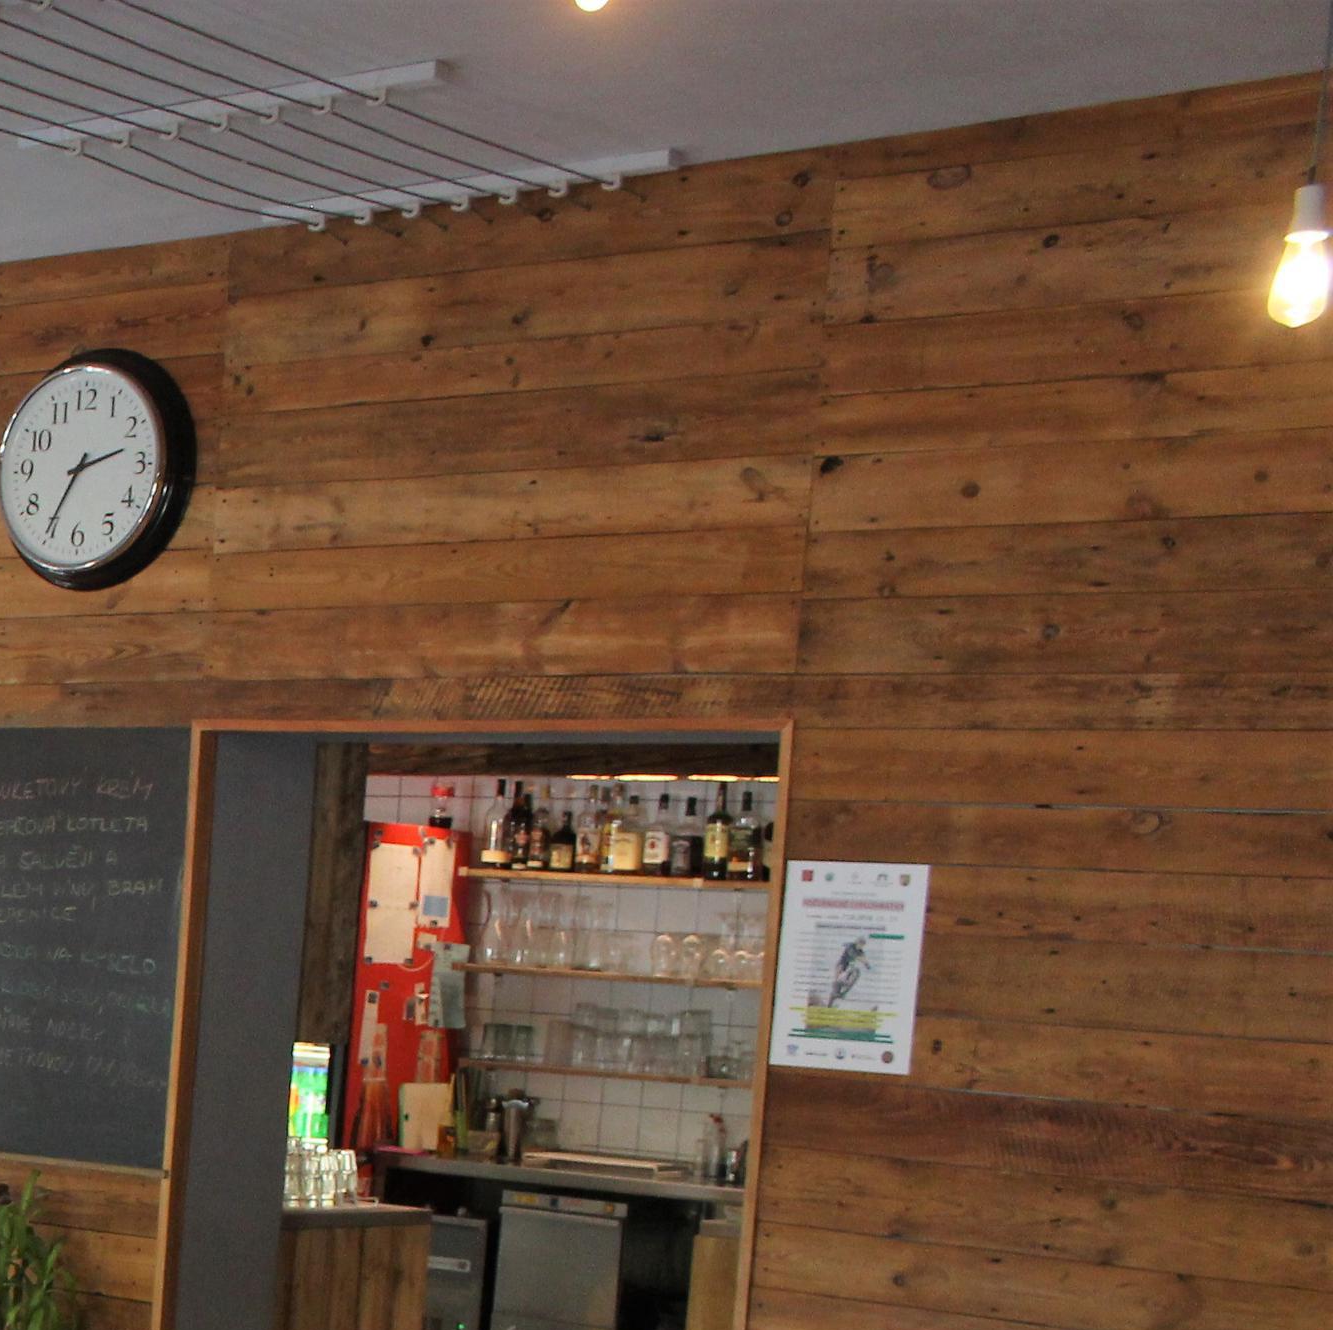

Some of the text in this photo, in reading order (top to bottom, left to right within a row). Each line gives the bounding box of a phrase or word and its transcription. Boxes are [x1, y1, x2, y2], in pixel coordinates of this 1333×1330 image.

[76, 388, 98, 412] 12
[110, 395, 117, 418] 1
[52, 401, 69, 425] 11
[124, 415, 138, 438] 2
[32, 428, 52, 452] 10
[20, 458, 34, 483] 9
[134, 450, 147, 475] 3
[25, 493, 40, 516] 8
[120, 484, 135, 508] 4
[47, 516, 60, 539] 7
[70, 521, 85, 547] 6
[101, 512, 115, 536] 5
